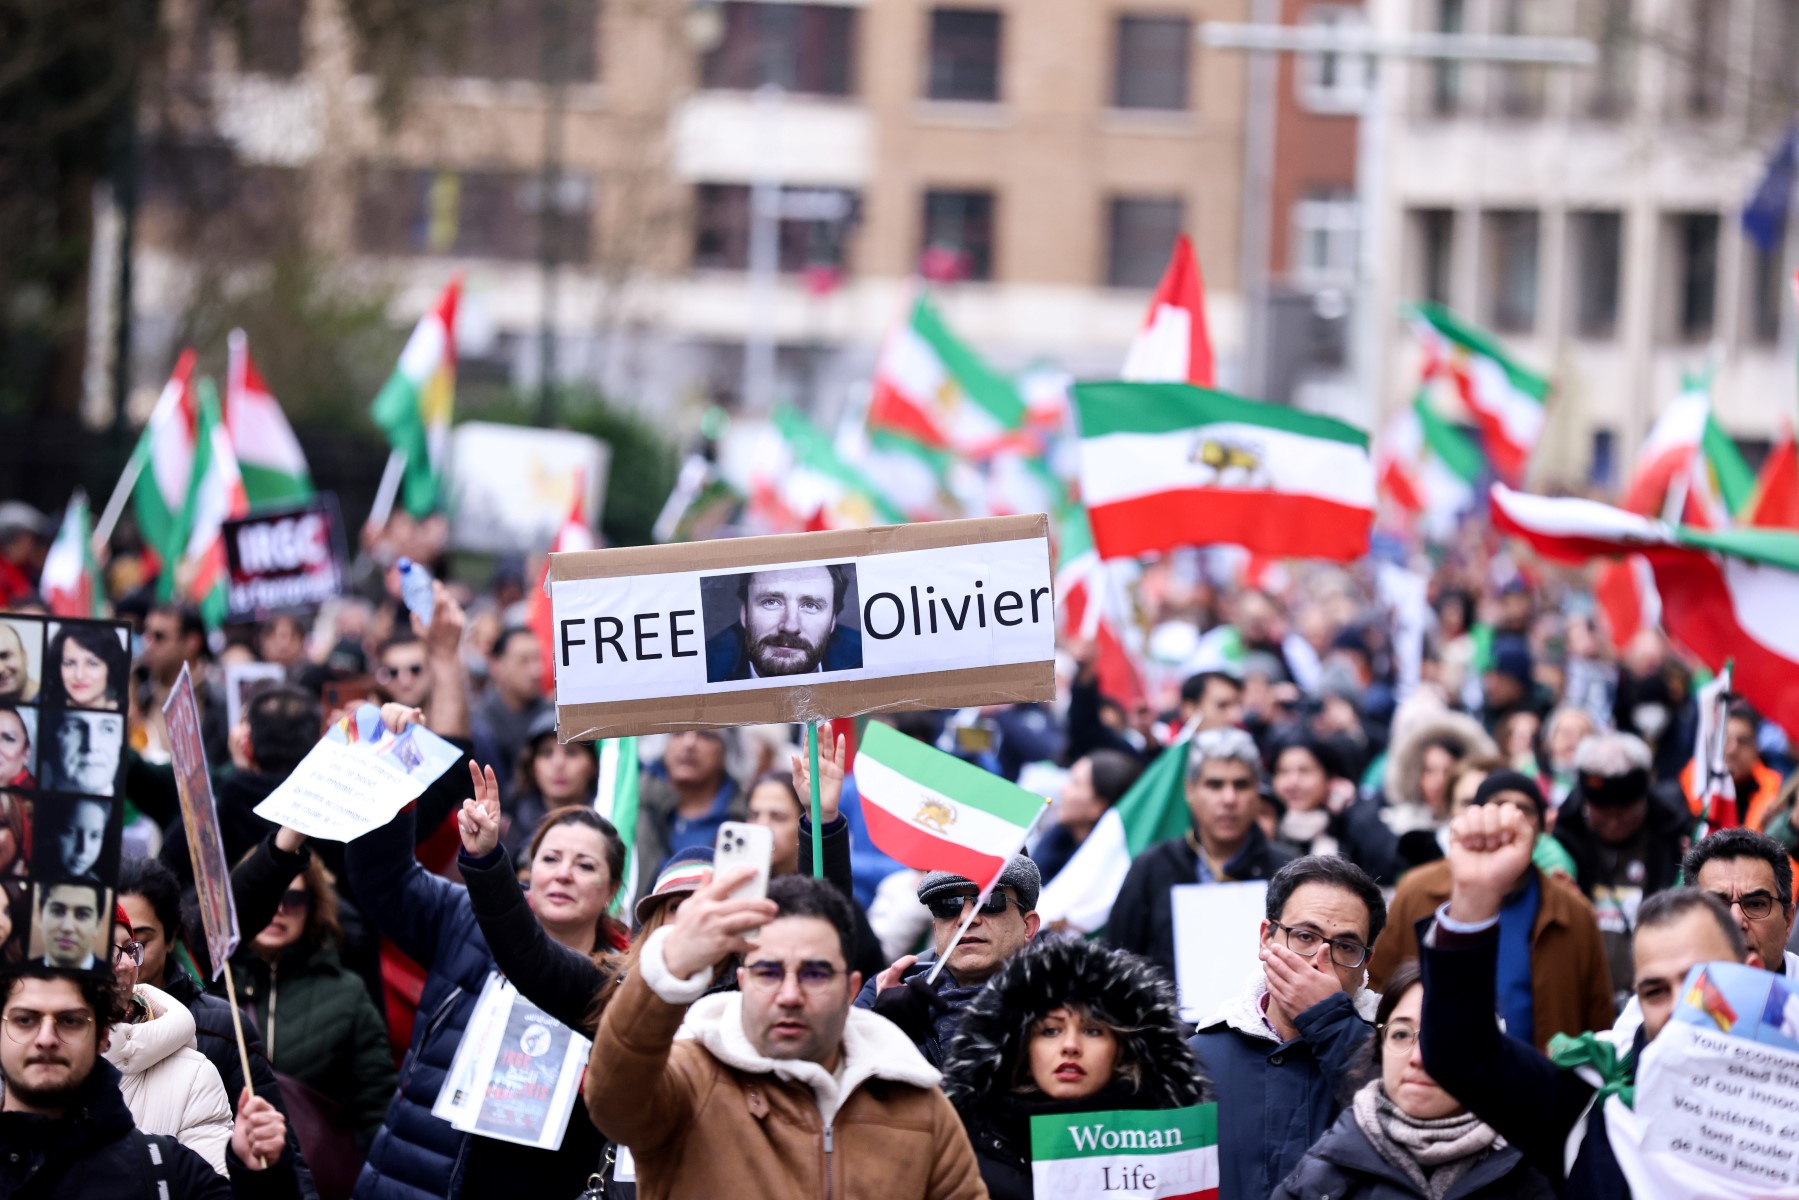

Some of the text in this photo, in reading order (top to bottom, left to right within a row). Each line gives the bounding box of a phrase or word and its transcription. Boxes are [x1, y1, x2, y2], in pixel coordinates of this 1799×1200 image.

[559, 580, 1049, 667] FREE Olivier
[1693, 1033, 1728, 1054] Your
[1692, 1075, 1710, 1089] of
[1716, 1081, 1744, 1097] our
[1728, 1065, 1771, 1083] shed
[1673, 1095, 1702, 1116] Vos
[1708, 1107, 1774, 1136] intérêts
[1067, 1123, 1183, 1152] Woman
[1739, 1139, 1793, 1161] couler
[1671, 1138, 1693, 1153] de
[1698, 1146, 1728, 1164] nos
[1732, 1157, 1790, 1183] jeunes
[1101, 1164, 1157, 1191] Life
